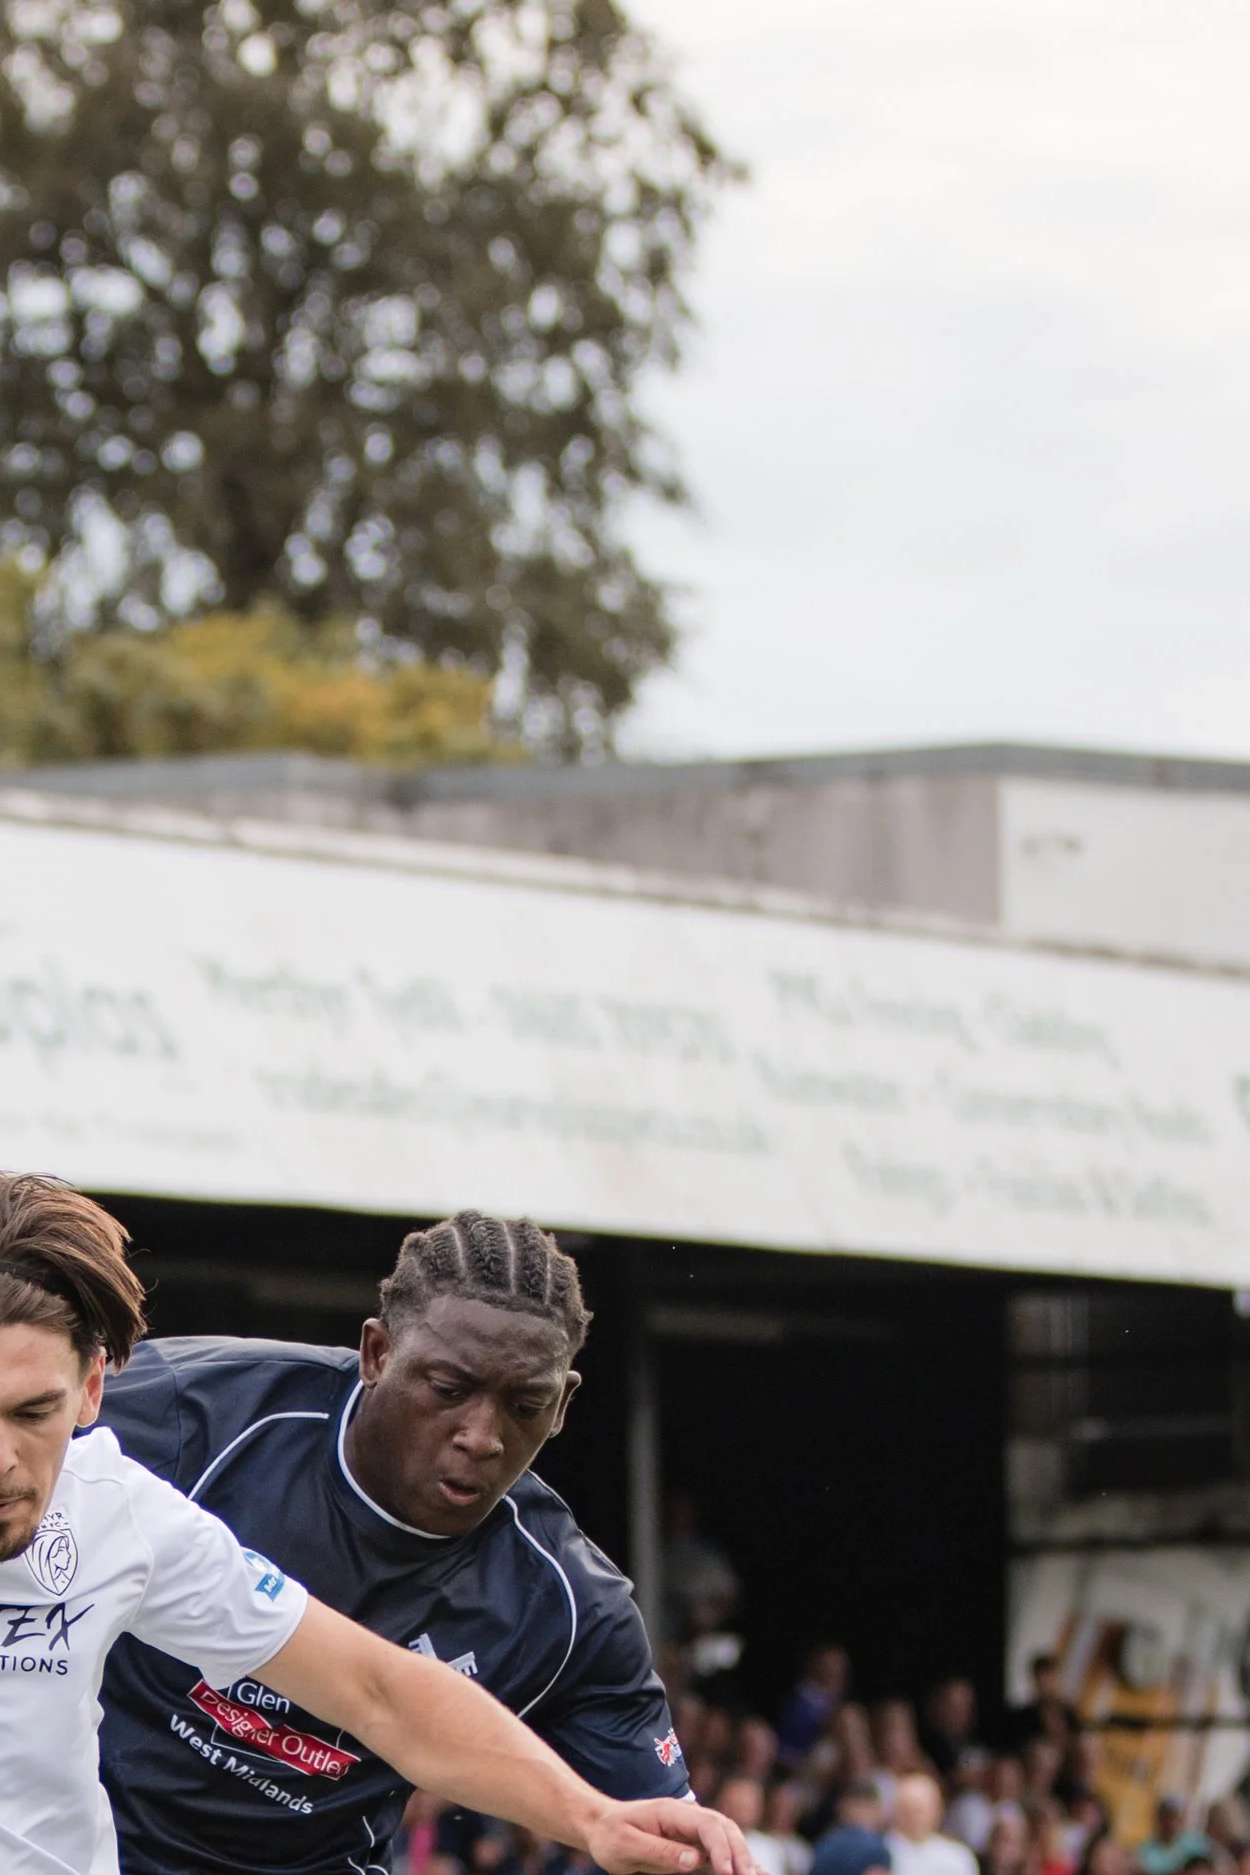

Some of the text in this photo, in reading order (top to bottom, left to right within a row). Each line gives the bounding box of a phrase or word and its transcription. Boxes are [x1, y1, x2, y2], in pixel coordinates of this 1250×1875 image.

[170, 1714, 314, 1815] West Midlands
[281, 1735, 344, 1775] Outle
